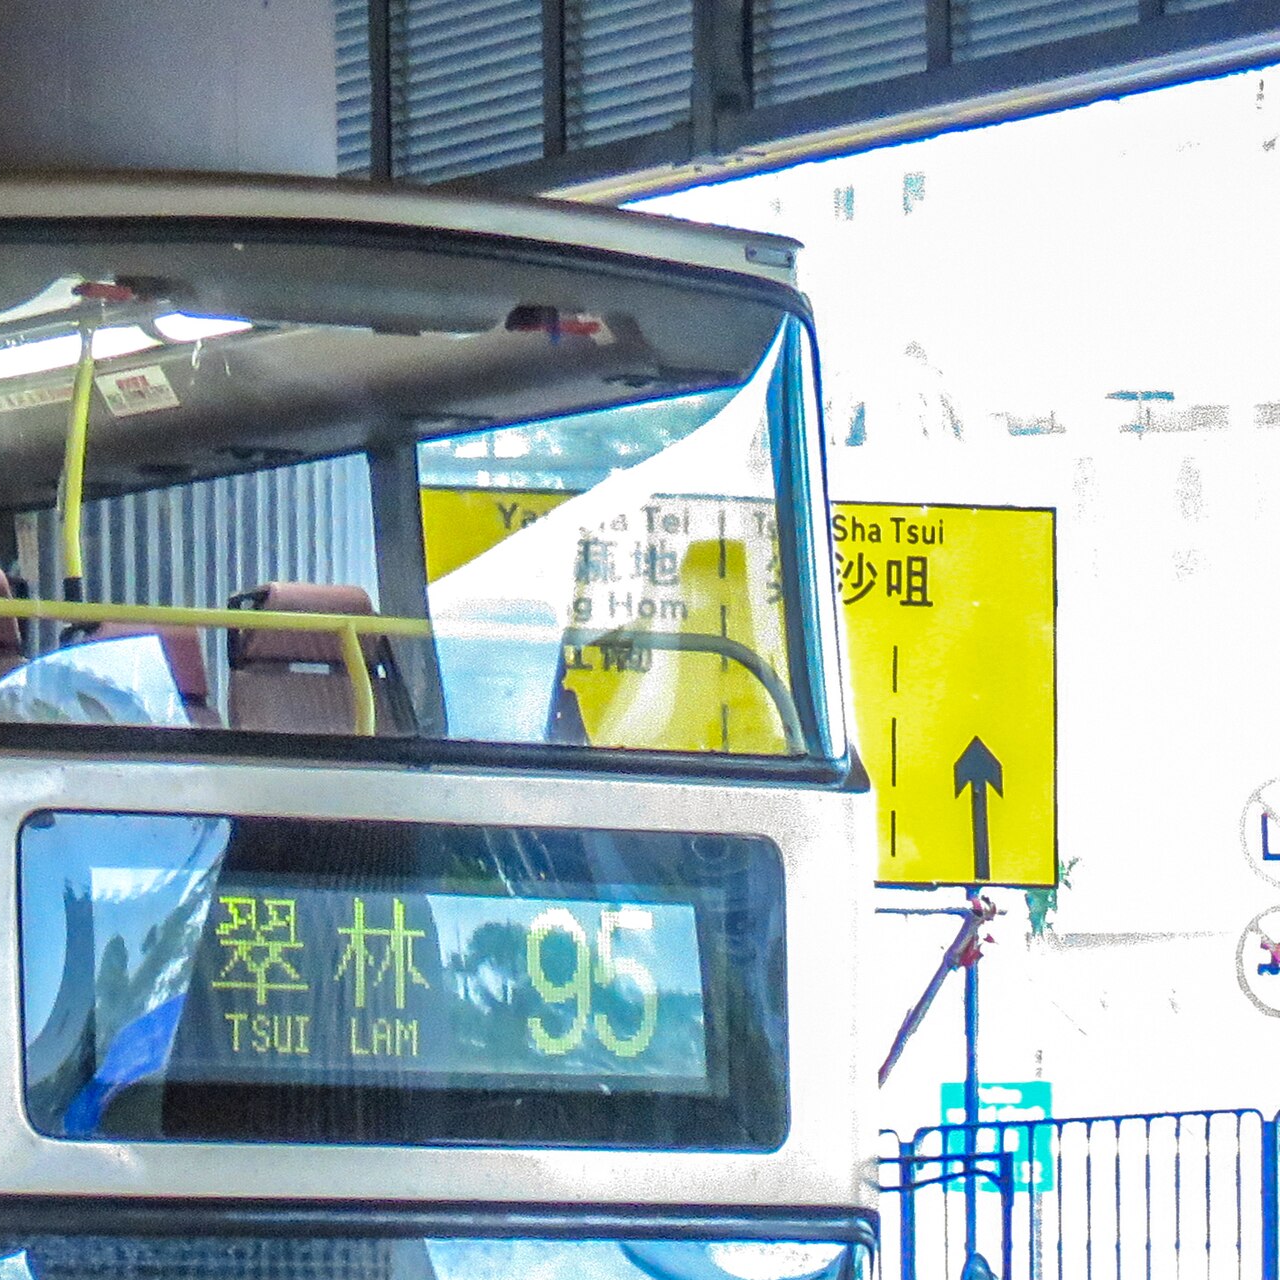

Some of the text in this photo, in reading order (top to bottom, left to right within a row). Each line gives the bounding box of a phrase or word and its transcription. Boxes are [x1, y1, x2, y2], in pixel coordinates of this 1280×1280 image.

[832, 504, 944, 545] Sha Tsui
[526, 906, 659, 1058] 95
[224, 1012, 419, 1057] TSUI LAM
